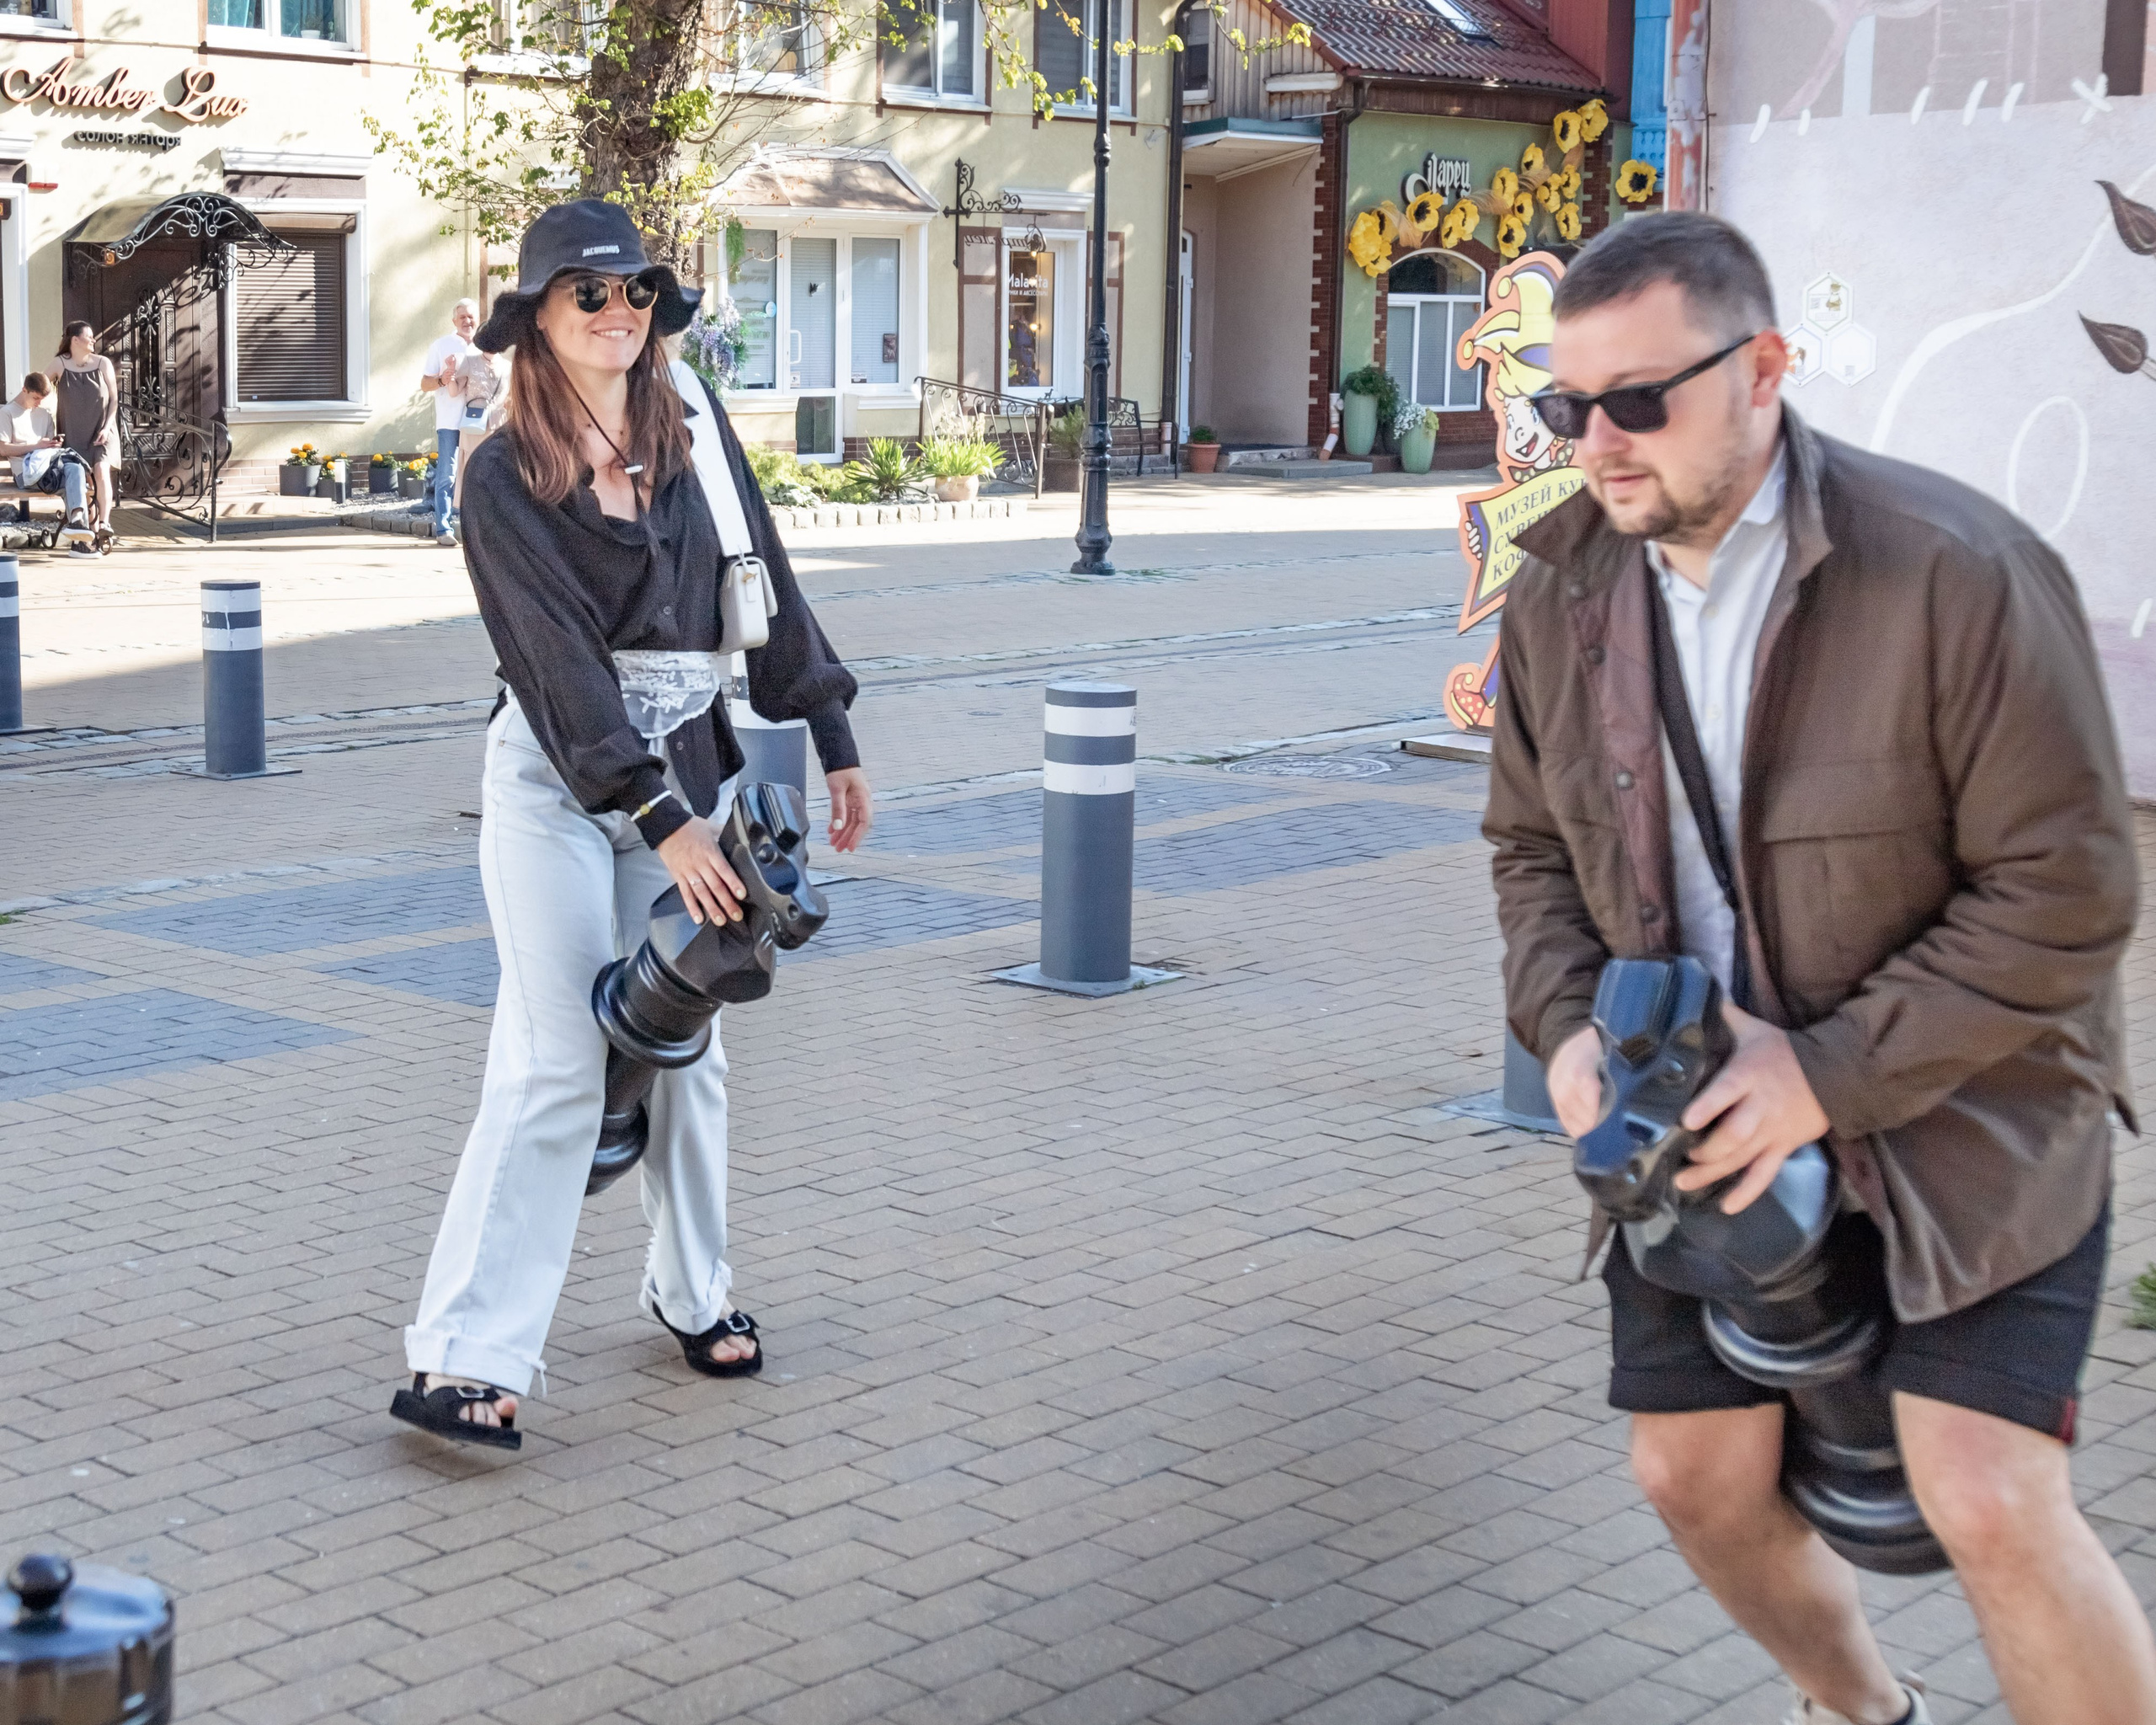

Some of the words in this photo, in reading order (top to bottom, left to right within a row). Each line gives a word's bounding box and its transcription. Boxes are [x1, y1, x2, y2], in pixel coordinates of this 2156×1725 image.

[2, 56, 157, 109] Amber
[160, 67, 250, 122] Lux
[74, 131, 124, 144] салон
[127, 133, 181, 150] янтаря
[1495, 483, 1551, 530] МУЗЕЙ
